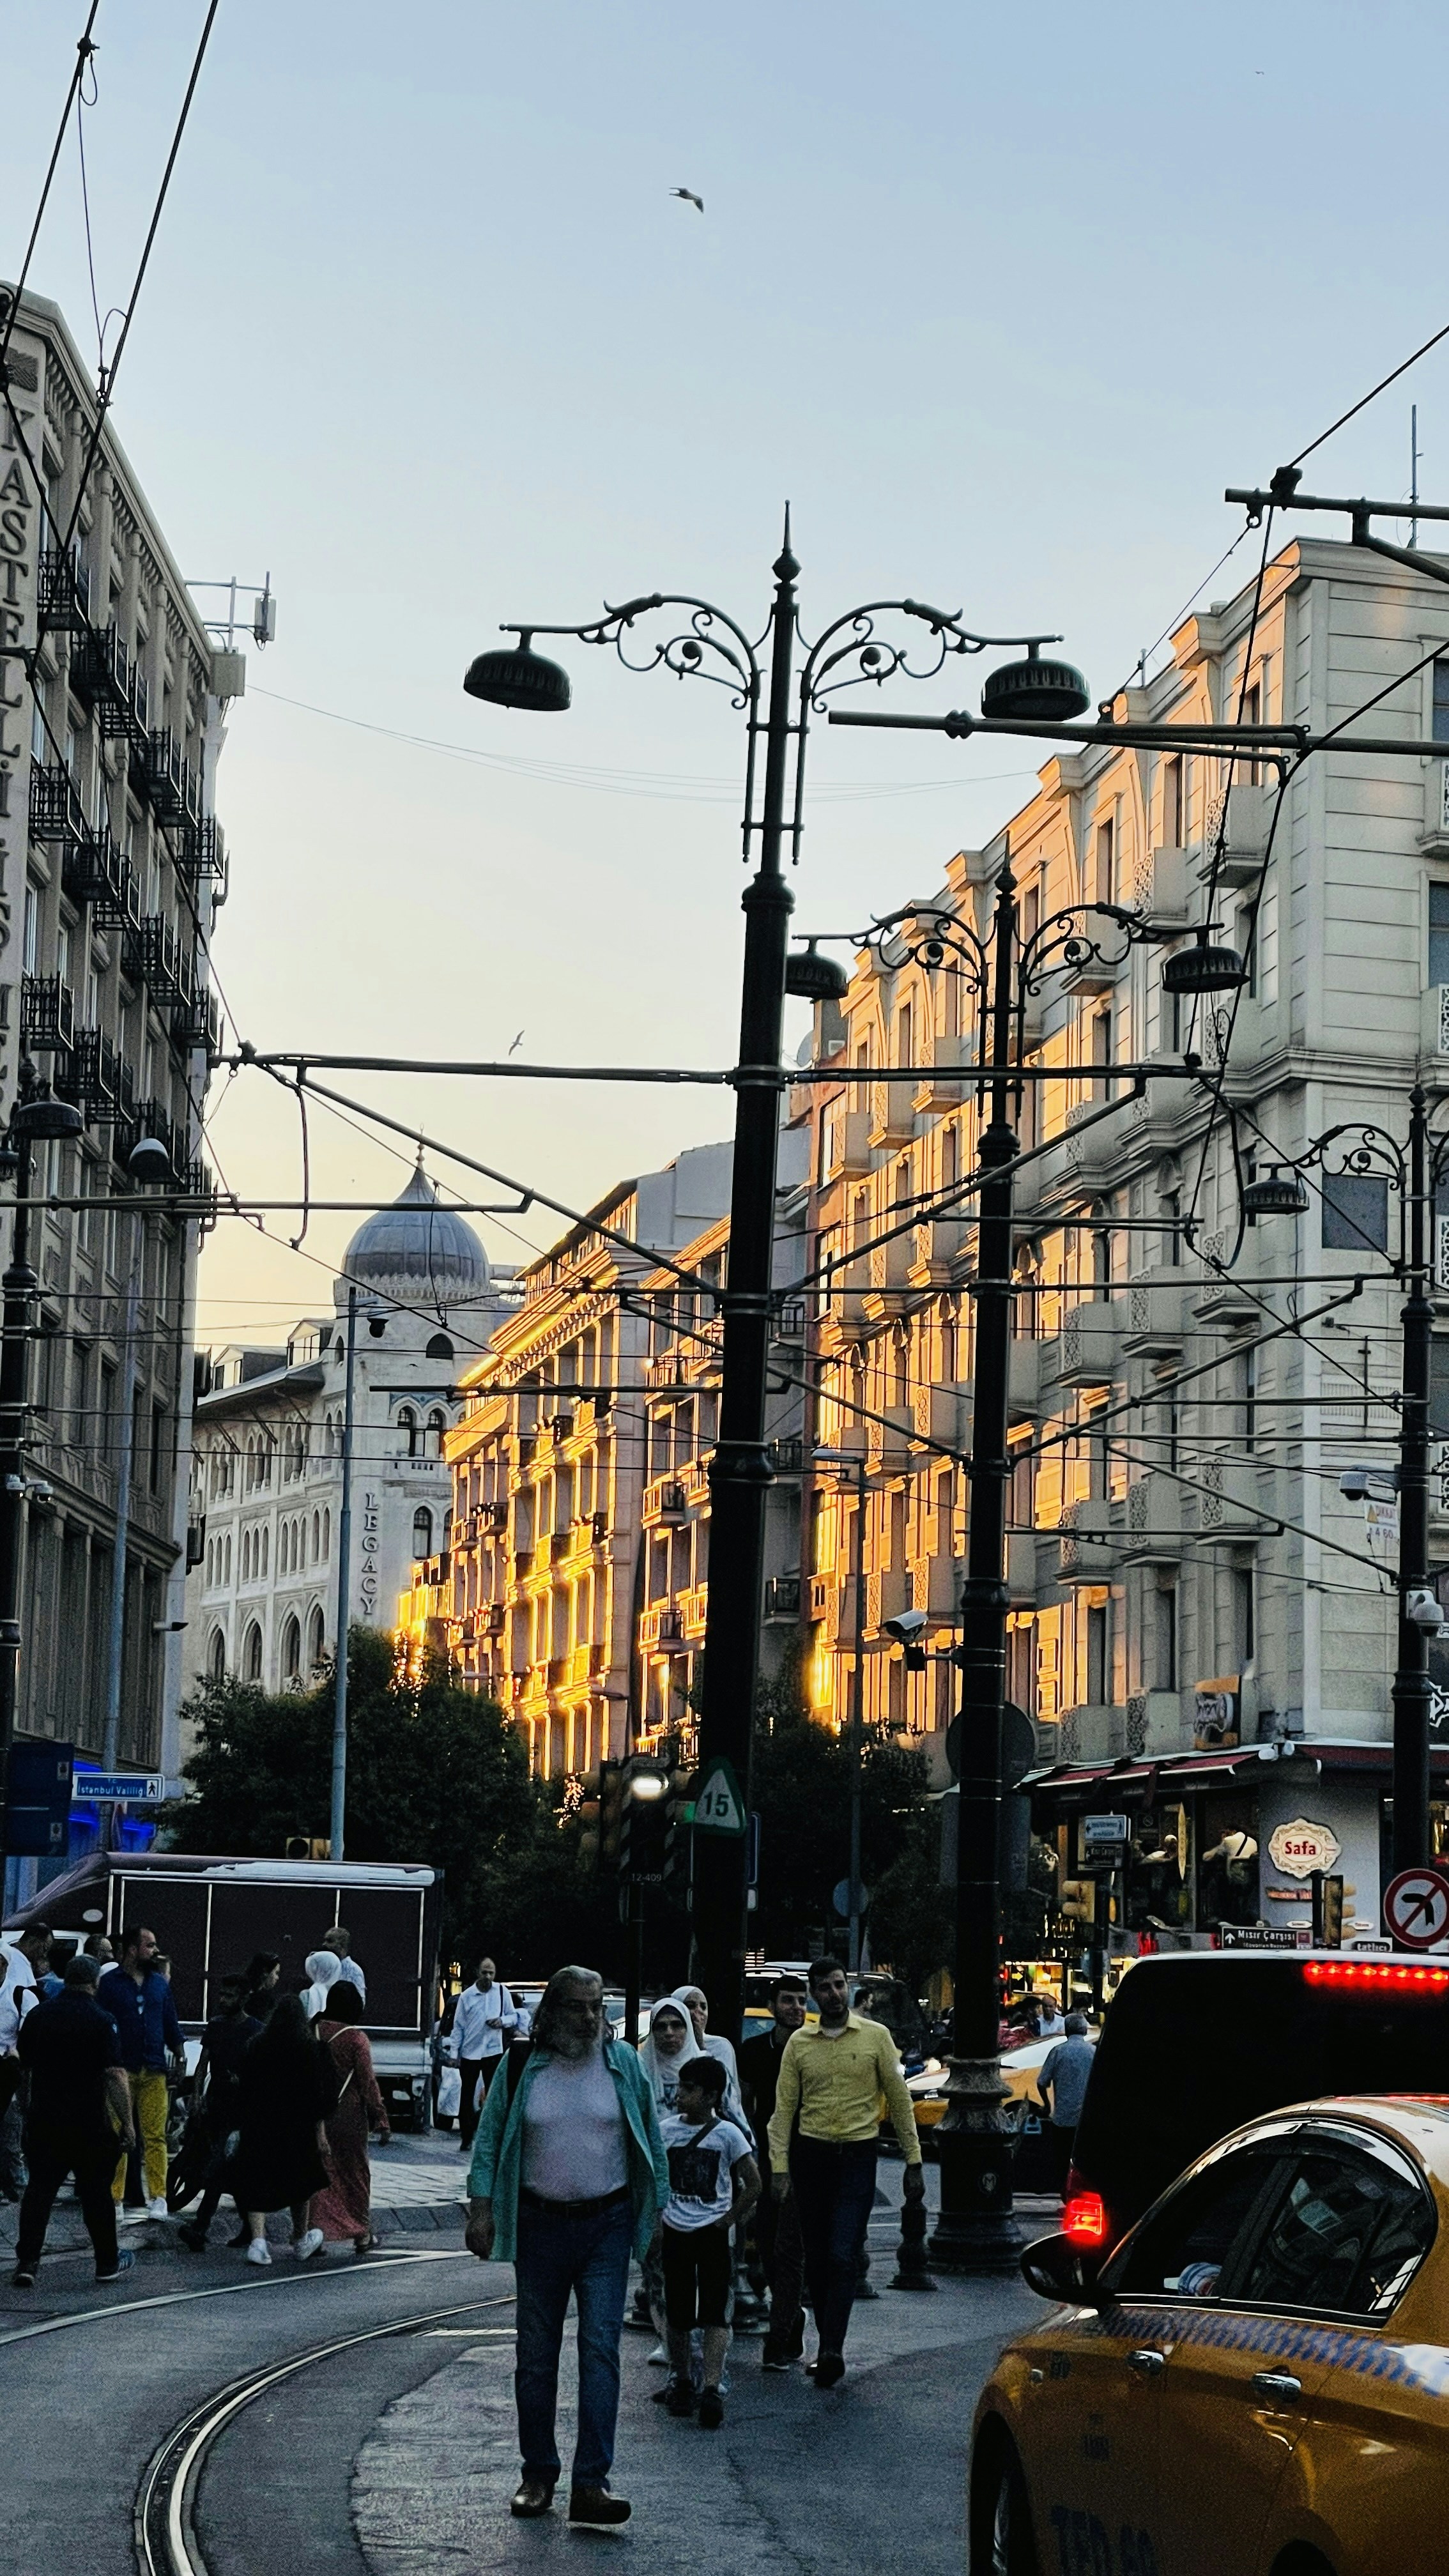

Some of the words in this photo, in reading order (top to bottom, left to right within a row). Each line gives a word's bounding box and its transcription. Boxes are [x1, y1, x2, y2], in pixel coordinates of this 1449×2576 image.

[362, 1492, 379, 1616] LEGACY
[703, 1791, 730, 1818] 15
[1284, 1840, 1317, 1856] Safa
[1238, 1929, 1261, 1940] Mısır
[1263, 1931, 1295, 1942] Çarşısı
